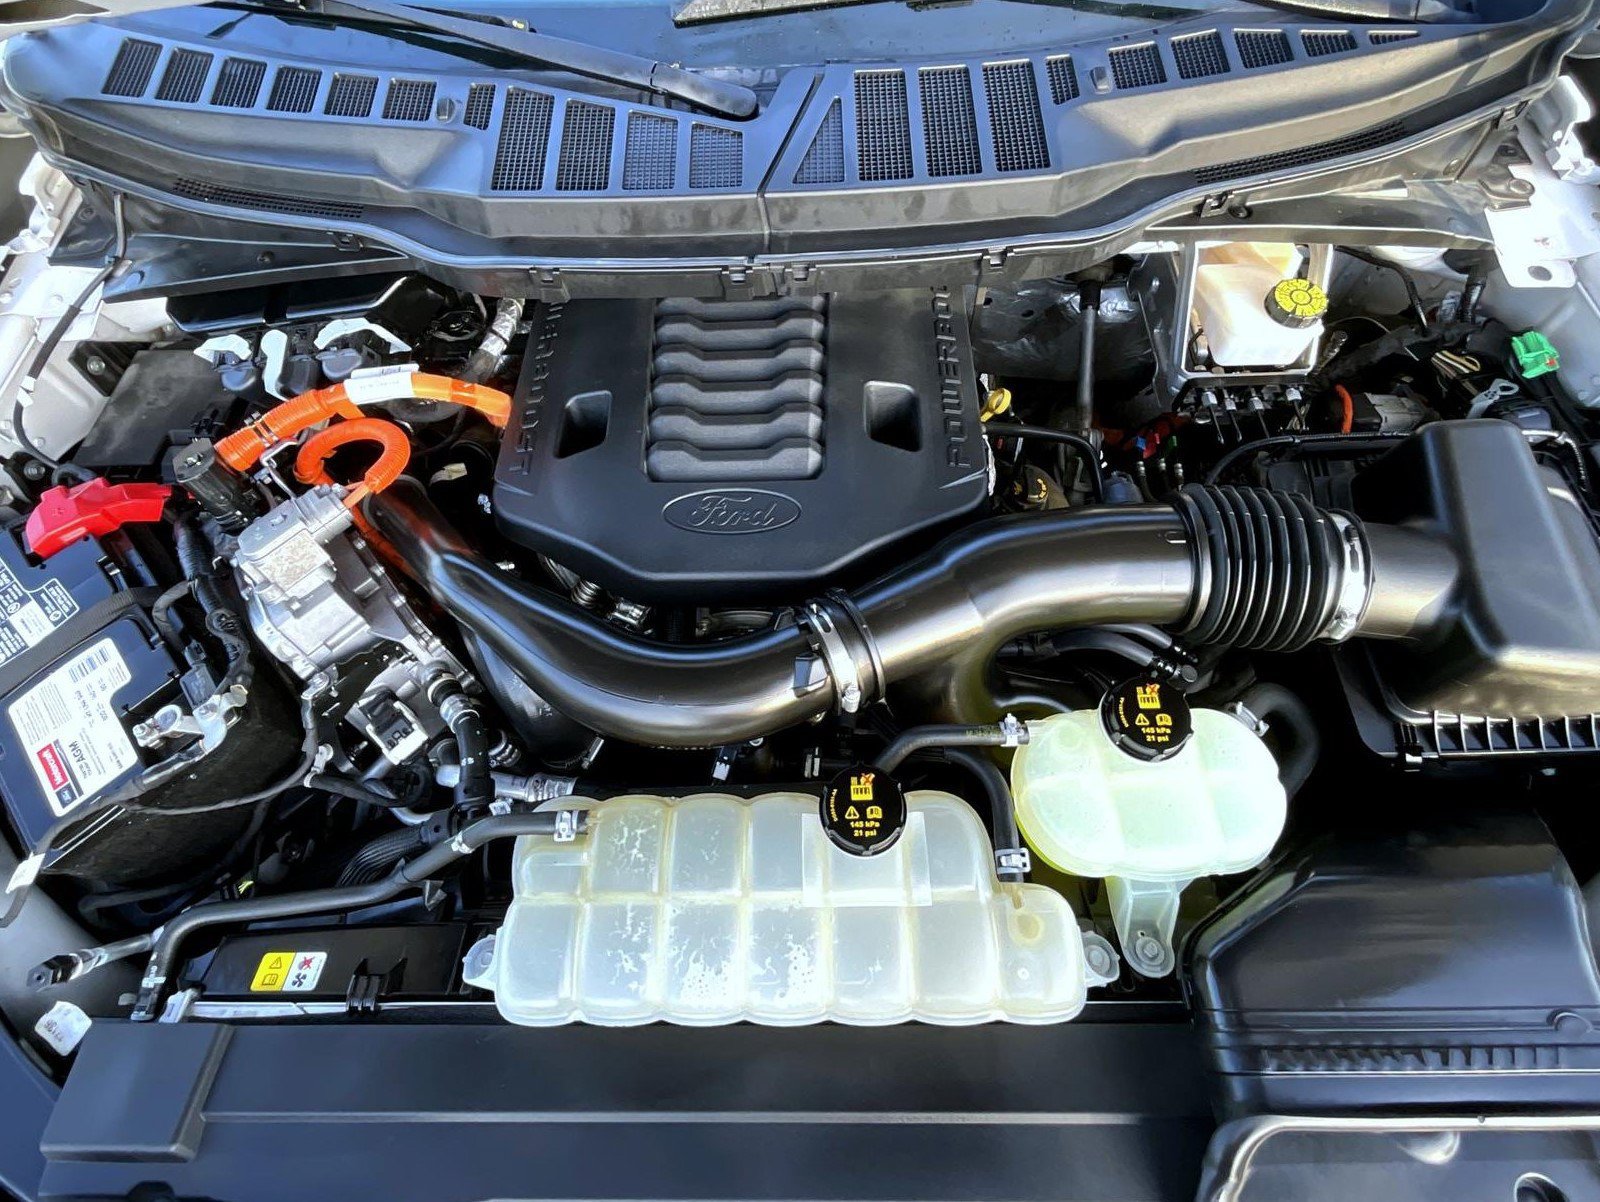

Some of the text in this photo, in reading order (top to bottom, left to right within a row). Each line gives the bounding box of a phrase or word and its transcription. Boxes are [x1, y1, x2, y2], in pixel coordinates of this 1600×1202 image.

[688, 495, 777, 527] Ford
[1157, 735, 1169, 743] psi
[68, 740, 86, 764] AGM
[853, 829, 877, 838] 21 psi
